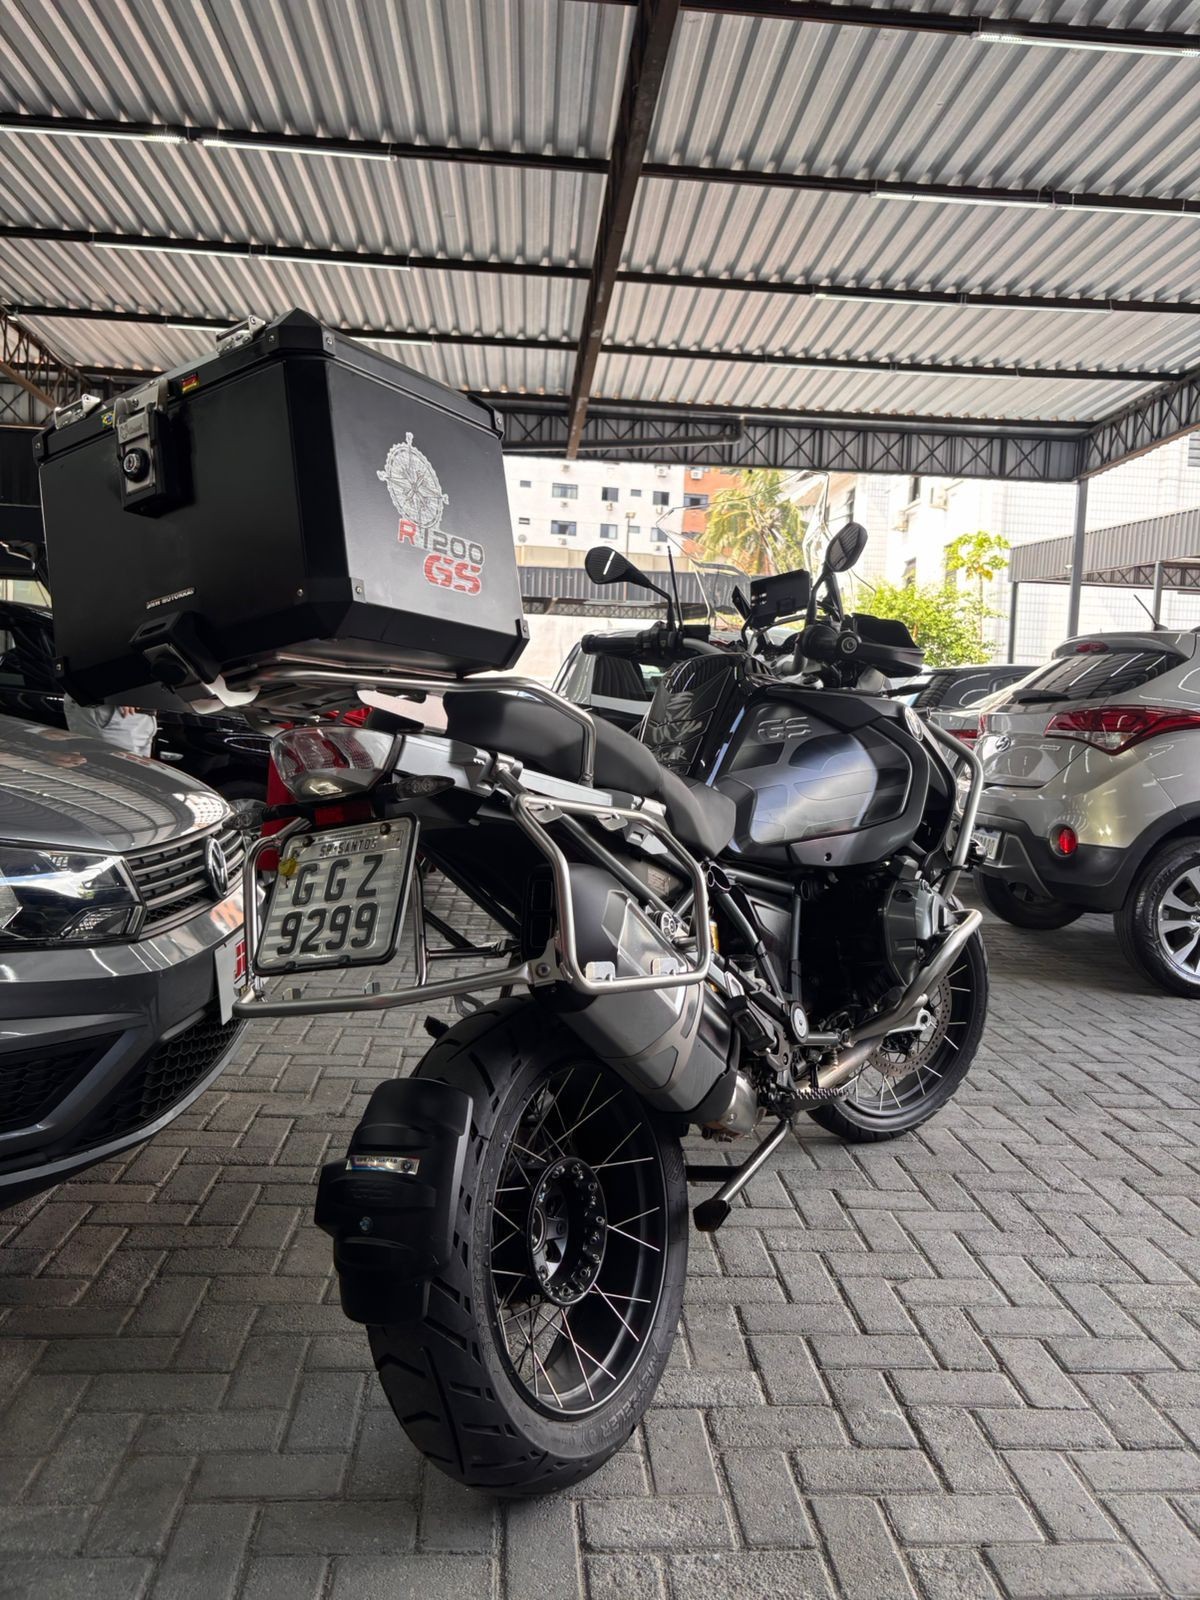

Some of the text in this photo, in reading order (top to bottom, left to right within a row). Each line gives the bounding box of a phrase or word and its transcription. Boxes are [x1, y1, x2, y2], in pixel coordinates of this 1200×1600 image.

[424, 554, 482, 595] GS
[757, 716, 812, 739] GS
[292, 854, 384, 906] GGZ
[277, 902, 379, 955] 9299
